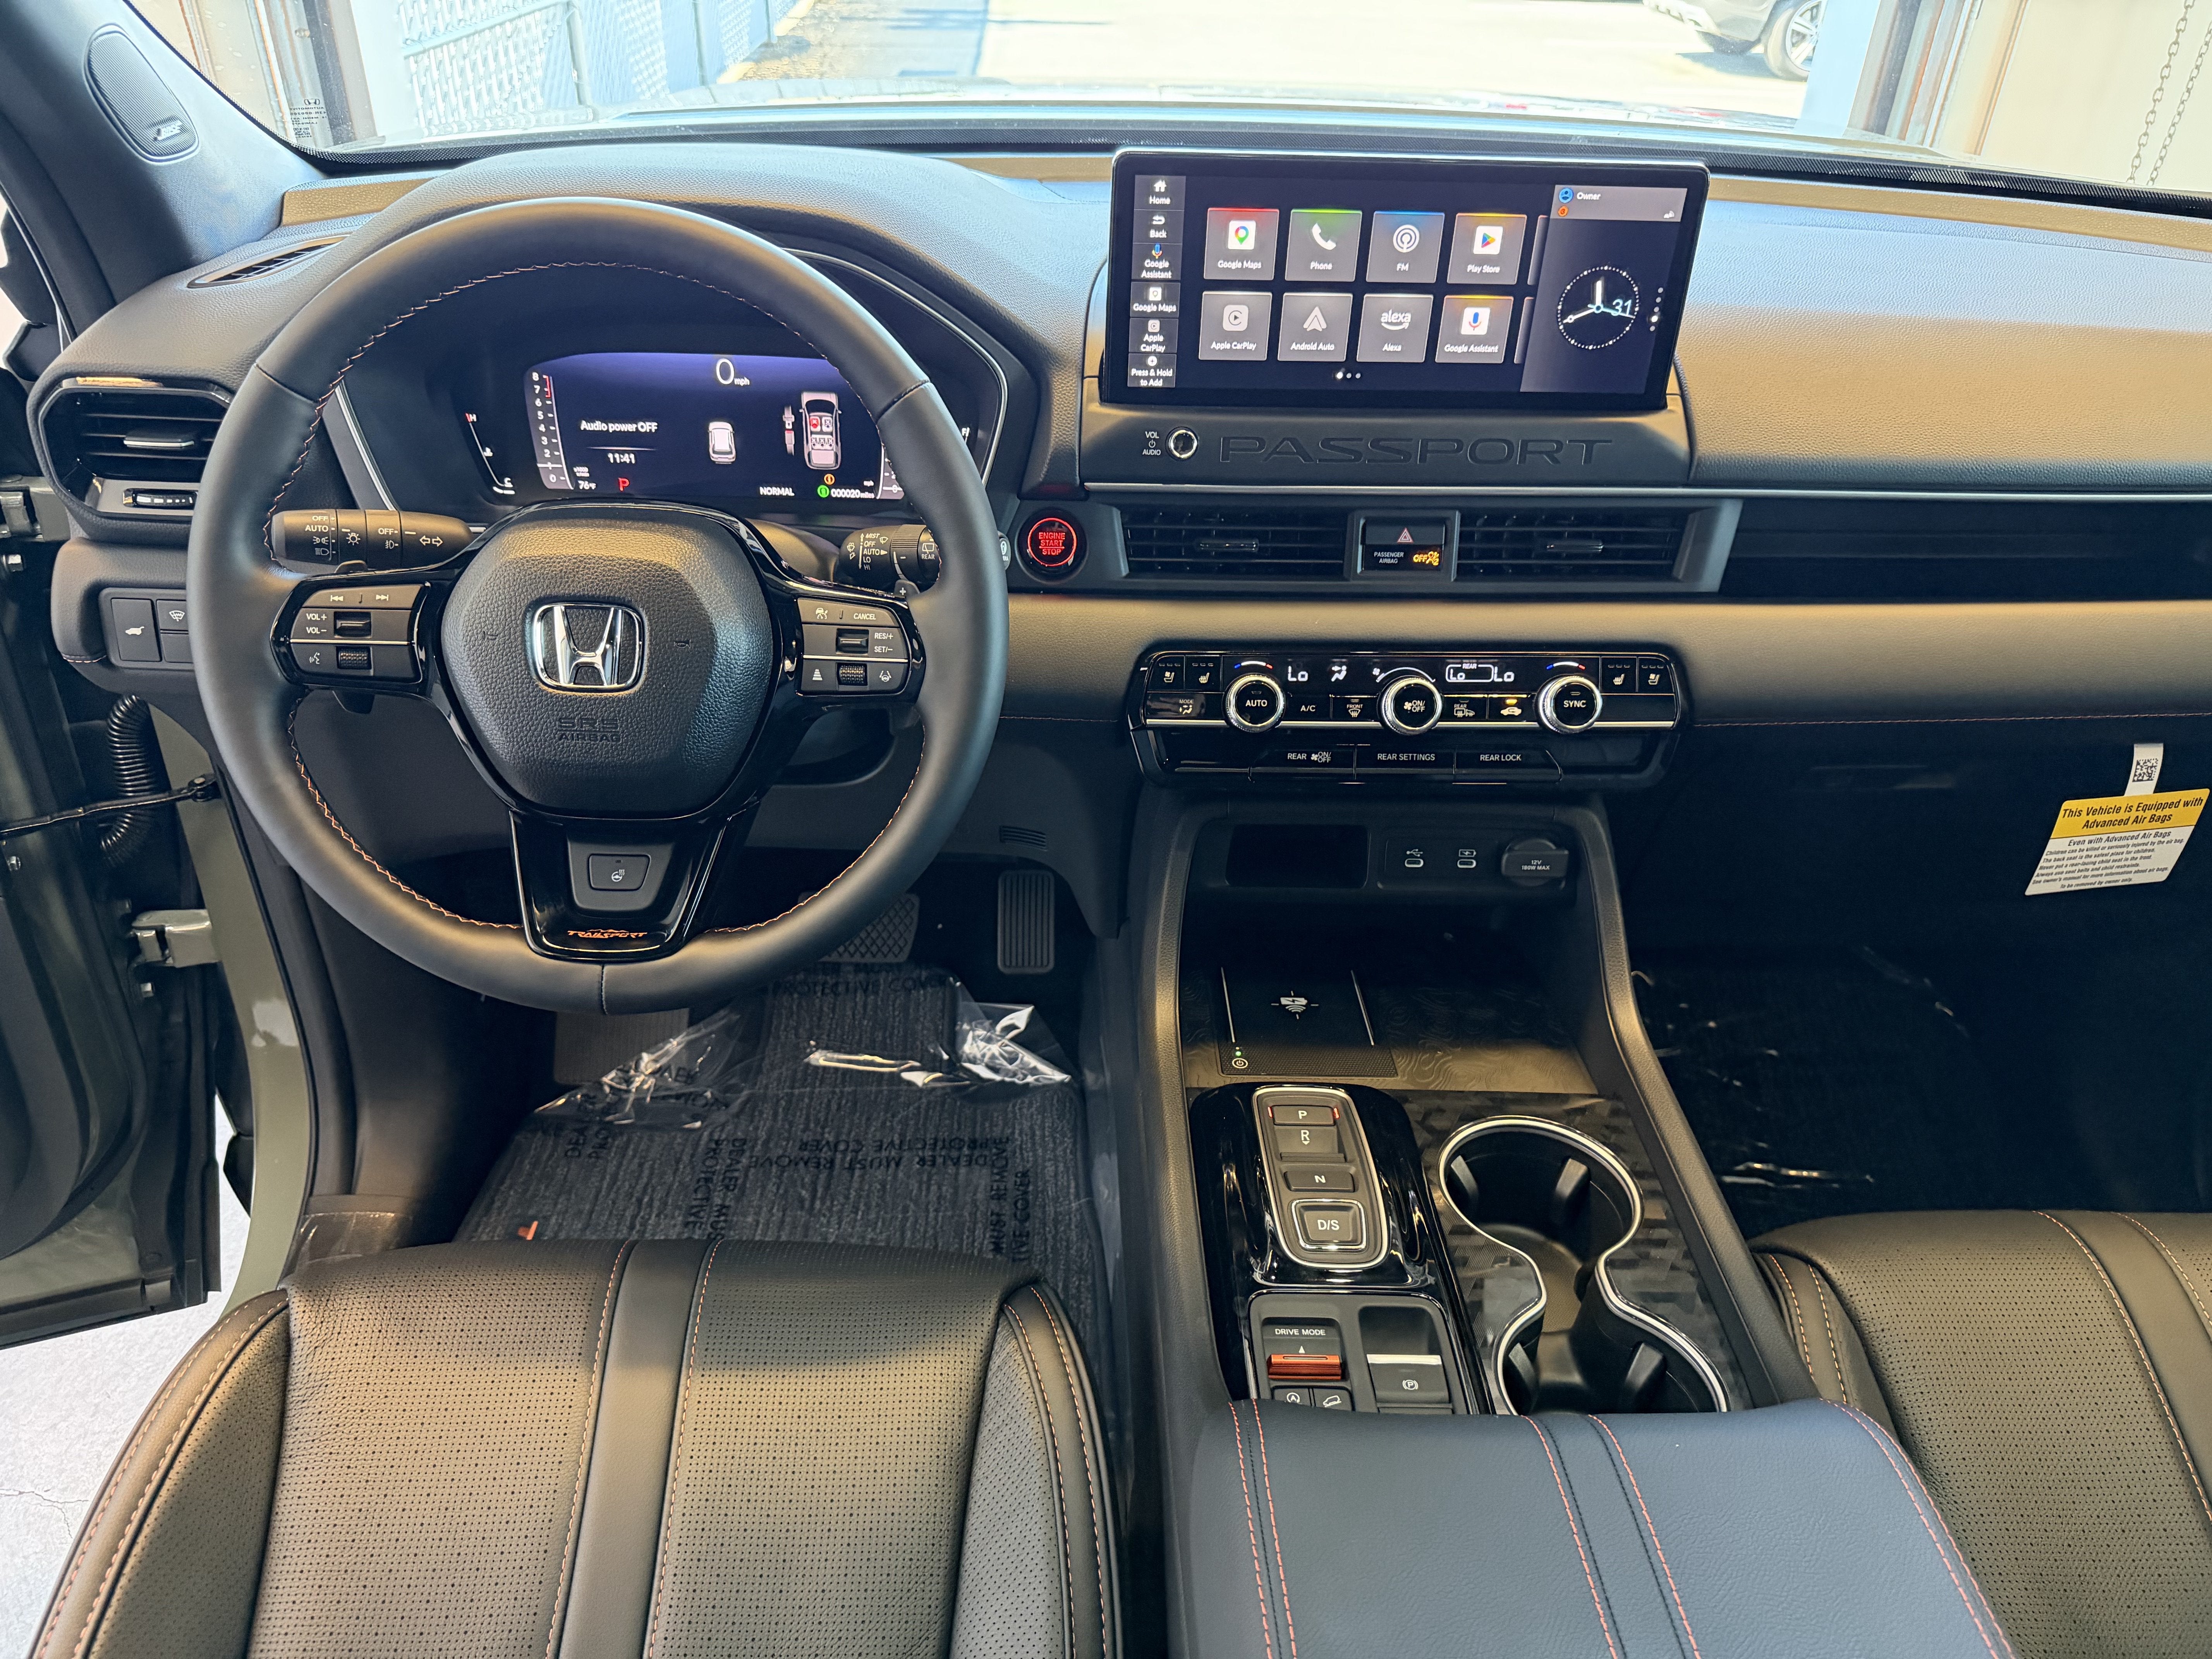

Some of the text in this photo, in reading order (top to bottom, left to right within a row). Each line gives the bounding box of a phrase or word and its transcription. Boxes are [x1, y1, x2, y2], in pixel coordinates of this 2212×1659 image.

[1149, 196, 1170, 204] Home
[1150, 229, 1166, 238] Back
[1145, 259, 1169, 269] Google
[1218, 260, 1261, 269] Google Maps
[1310, 261, 1332, 270] Phone
[1467, 264, 1482, 273] Play
[1141, 270, 1171, 278] Assistant
[1133, 303, 1176, 313] Google Maps
[1611, 297, 1631, 317] 31
[1381, 309, 1411, 324] alexa
[1144, 333, 1163, 342] Apple
[1141, 344, 1165, 352] CarPlay
[1211, 341, 1256, 350] Apple CarPlay
[1290, 342, 1317, 350] Android
[1444, 344, 1498, 353] Google Assistant
[716, 358, 749, 386] 0 mph
[532, 373, 539, 381] 8
[534, 385, 540, 393] 7
[535, 398, 542, 407] 6
[470, 414, 477, 422] H
[538, 411, 543, 419] 5
[581, 421, 657, 432] Audio power OFF
[542, 436, 548, 445] 3
[544, 449, 550, 457] 2
[1220, 436, 1613, 465] PASSPORT
[608, 453, 635, 463] 11:41
[550, 474, 556, 482] 0
[578, 480, 596, 489] 76°F
[619, 478, 629, 491] P
[760, 487, 794, 496] NORMAL
[831, 489, 862, 498] 000020
[1039, 532, 1065, 540] ENGINE
[1413, 554, 1427, 562] OFF
[1288, 666, 1308, 681] Lo
[1449, 669, 1466, 681] Lo
[1494, 666, 1515, 682] Lo
[558, 718, 619, 732] SRS
[558, 733, 620, 743] AIRBAG
[2063, 797, 2203, 818] This Vehicle is Equipped with
[2082, 813, 2172, 829] Advanced Air Bags
[2088, 836, 2102, 844] with
[2104, 833, 2140, 843] Advanced
[1298, 1111, 1307, 1119] P
[1301, 1130, 1310, 1140] R
[799, 1139, 863, 1153] COVER
[749, 1154, 988, 1170] DEALER MUST REMOVE
[989, 1136, 1009, 1201] REMOVE
[708, 1138, 747, 1240] DEALER MUS
[1013, 1169, 1031, 1223] COVER
[1317, 1220, 1339, 1230] D/S
